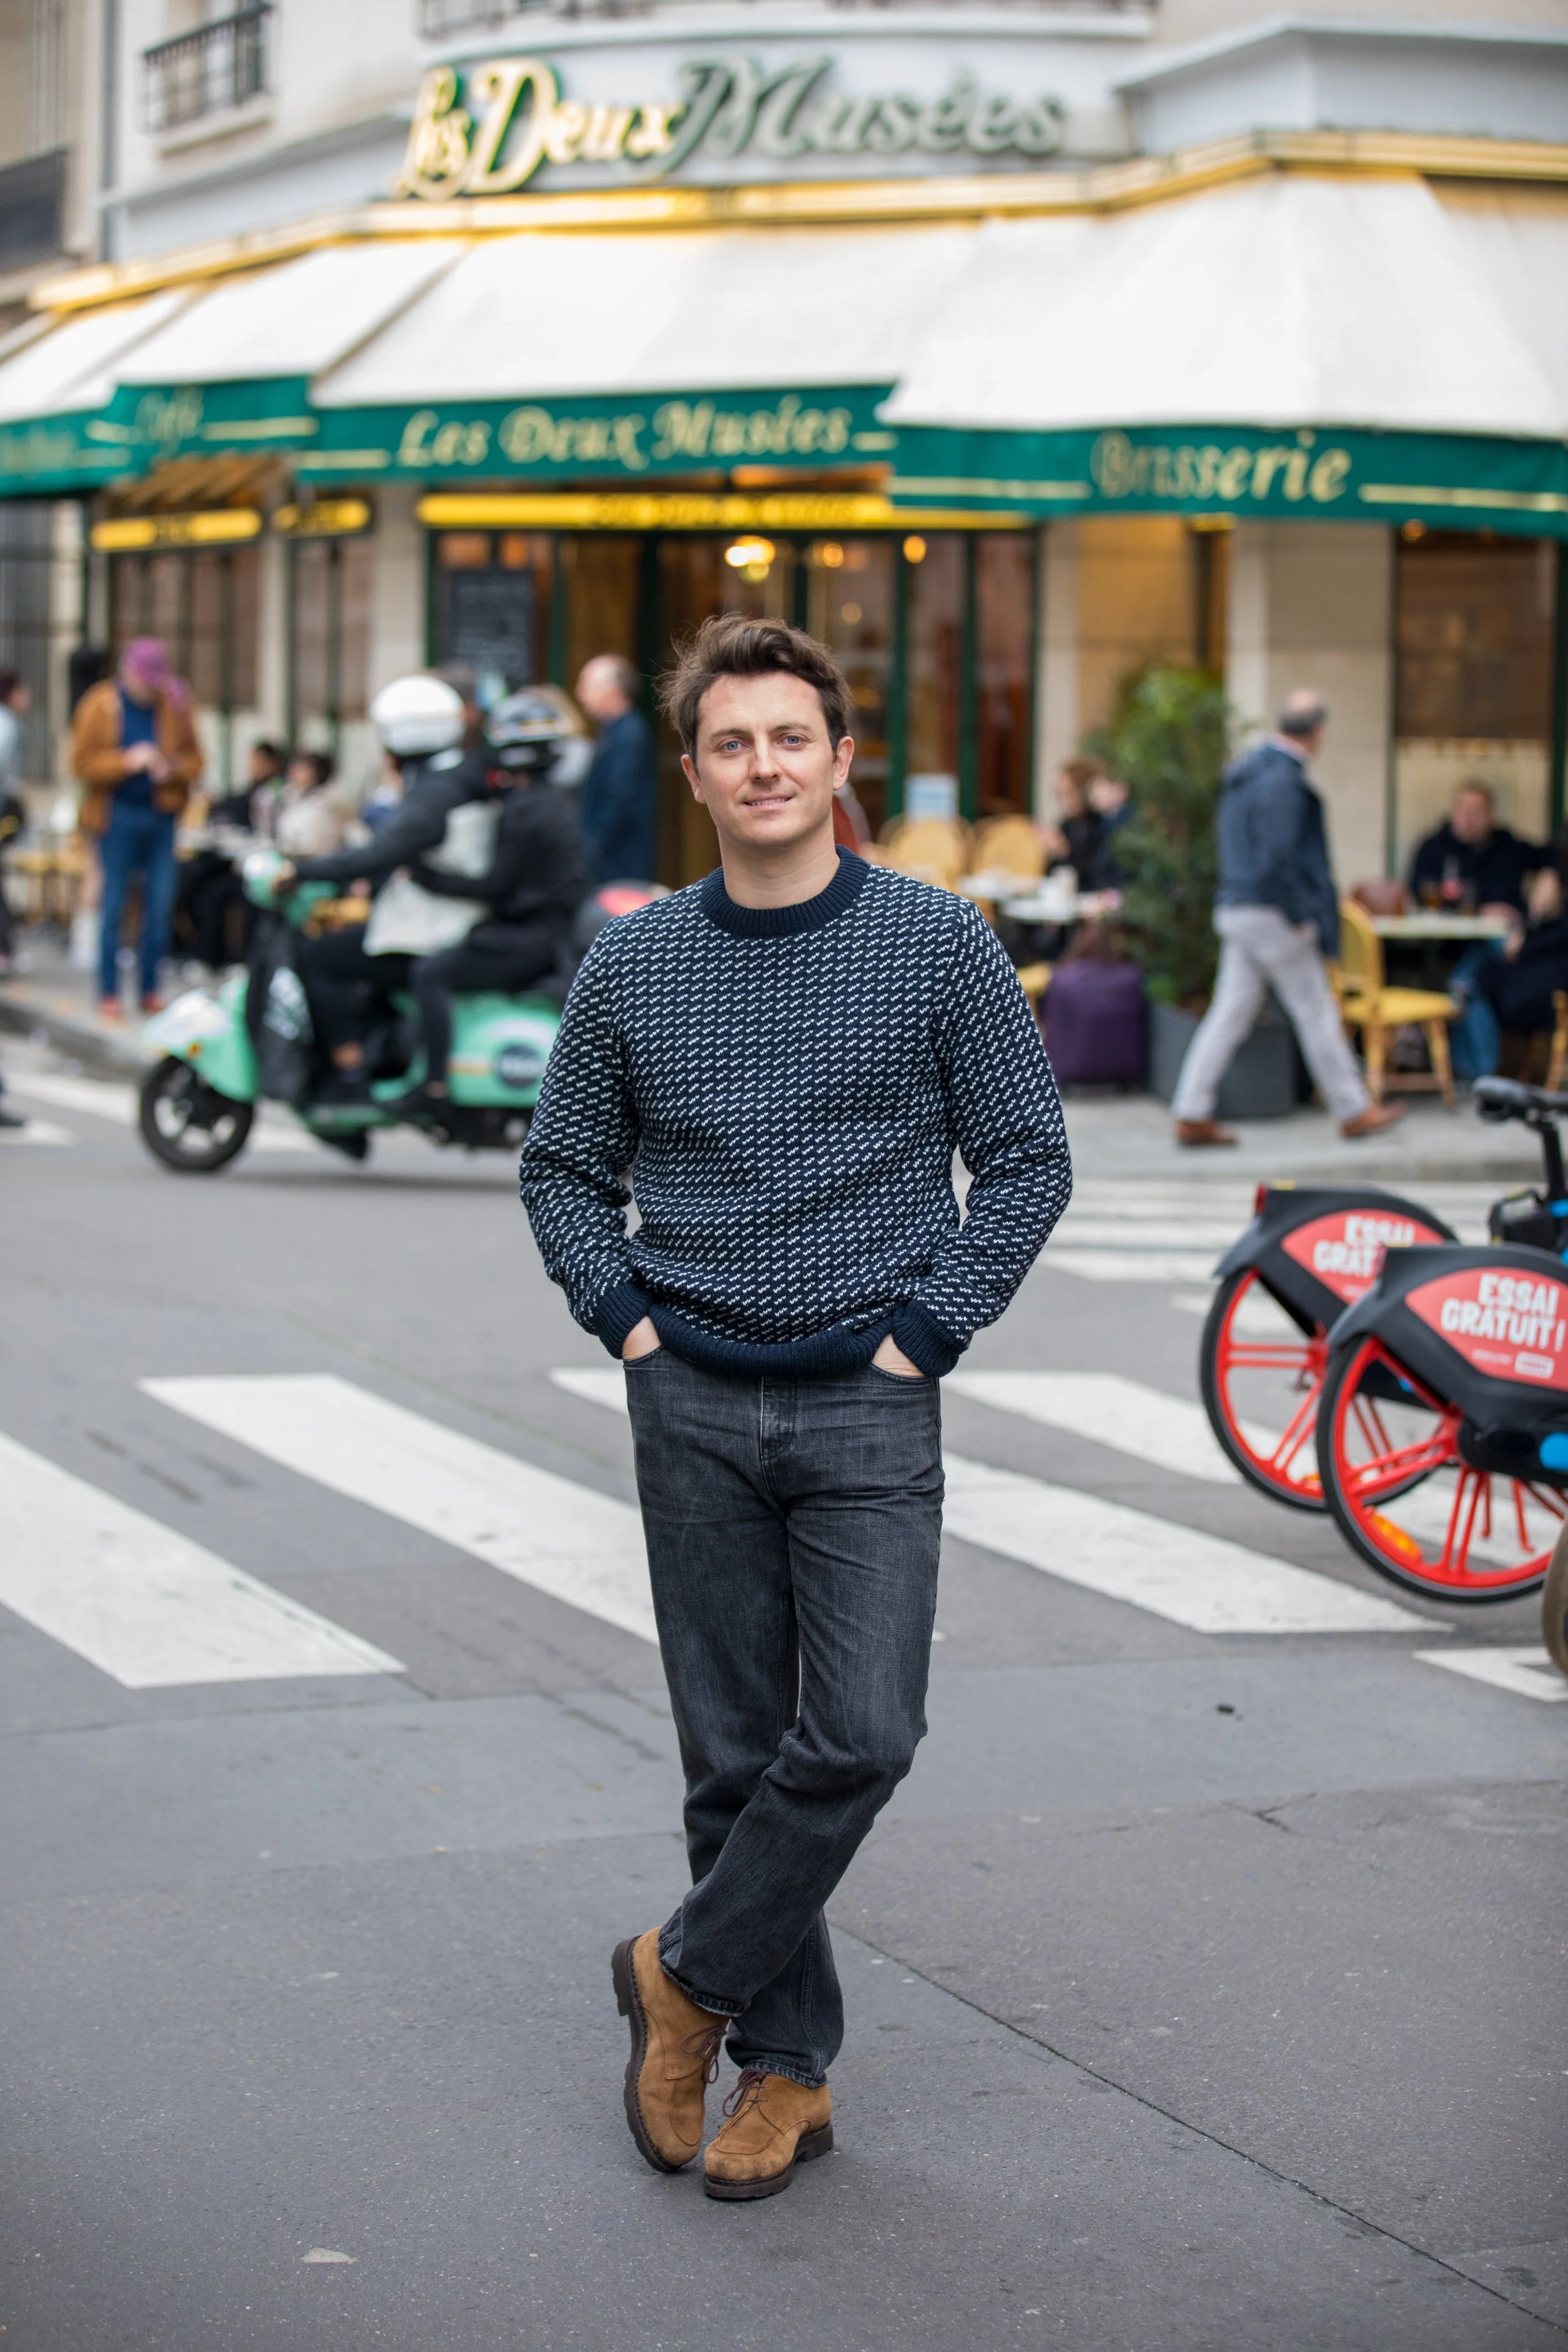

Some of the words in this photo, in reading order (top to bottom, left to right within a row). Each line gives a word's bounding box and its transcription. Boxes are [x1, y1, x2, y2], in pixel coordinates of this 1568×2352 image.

[467, 59, 682, 191] Deux
[625, 53, 1067, 181] Musées
[394, 410, 492, 467] Les
[499, 406, 650, 471] Deux
[1478, 1272, 1560, 1316] ESSAI
